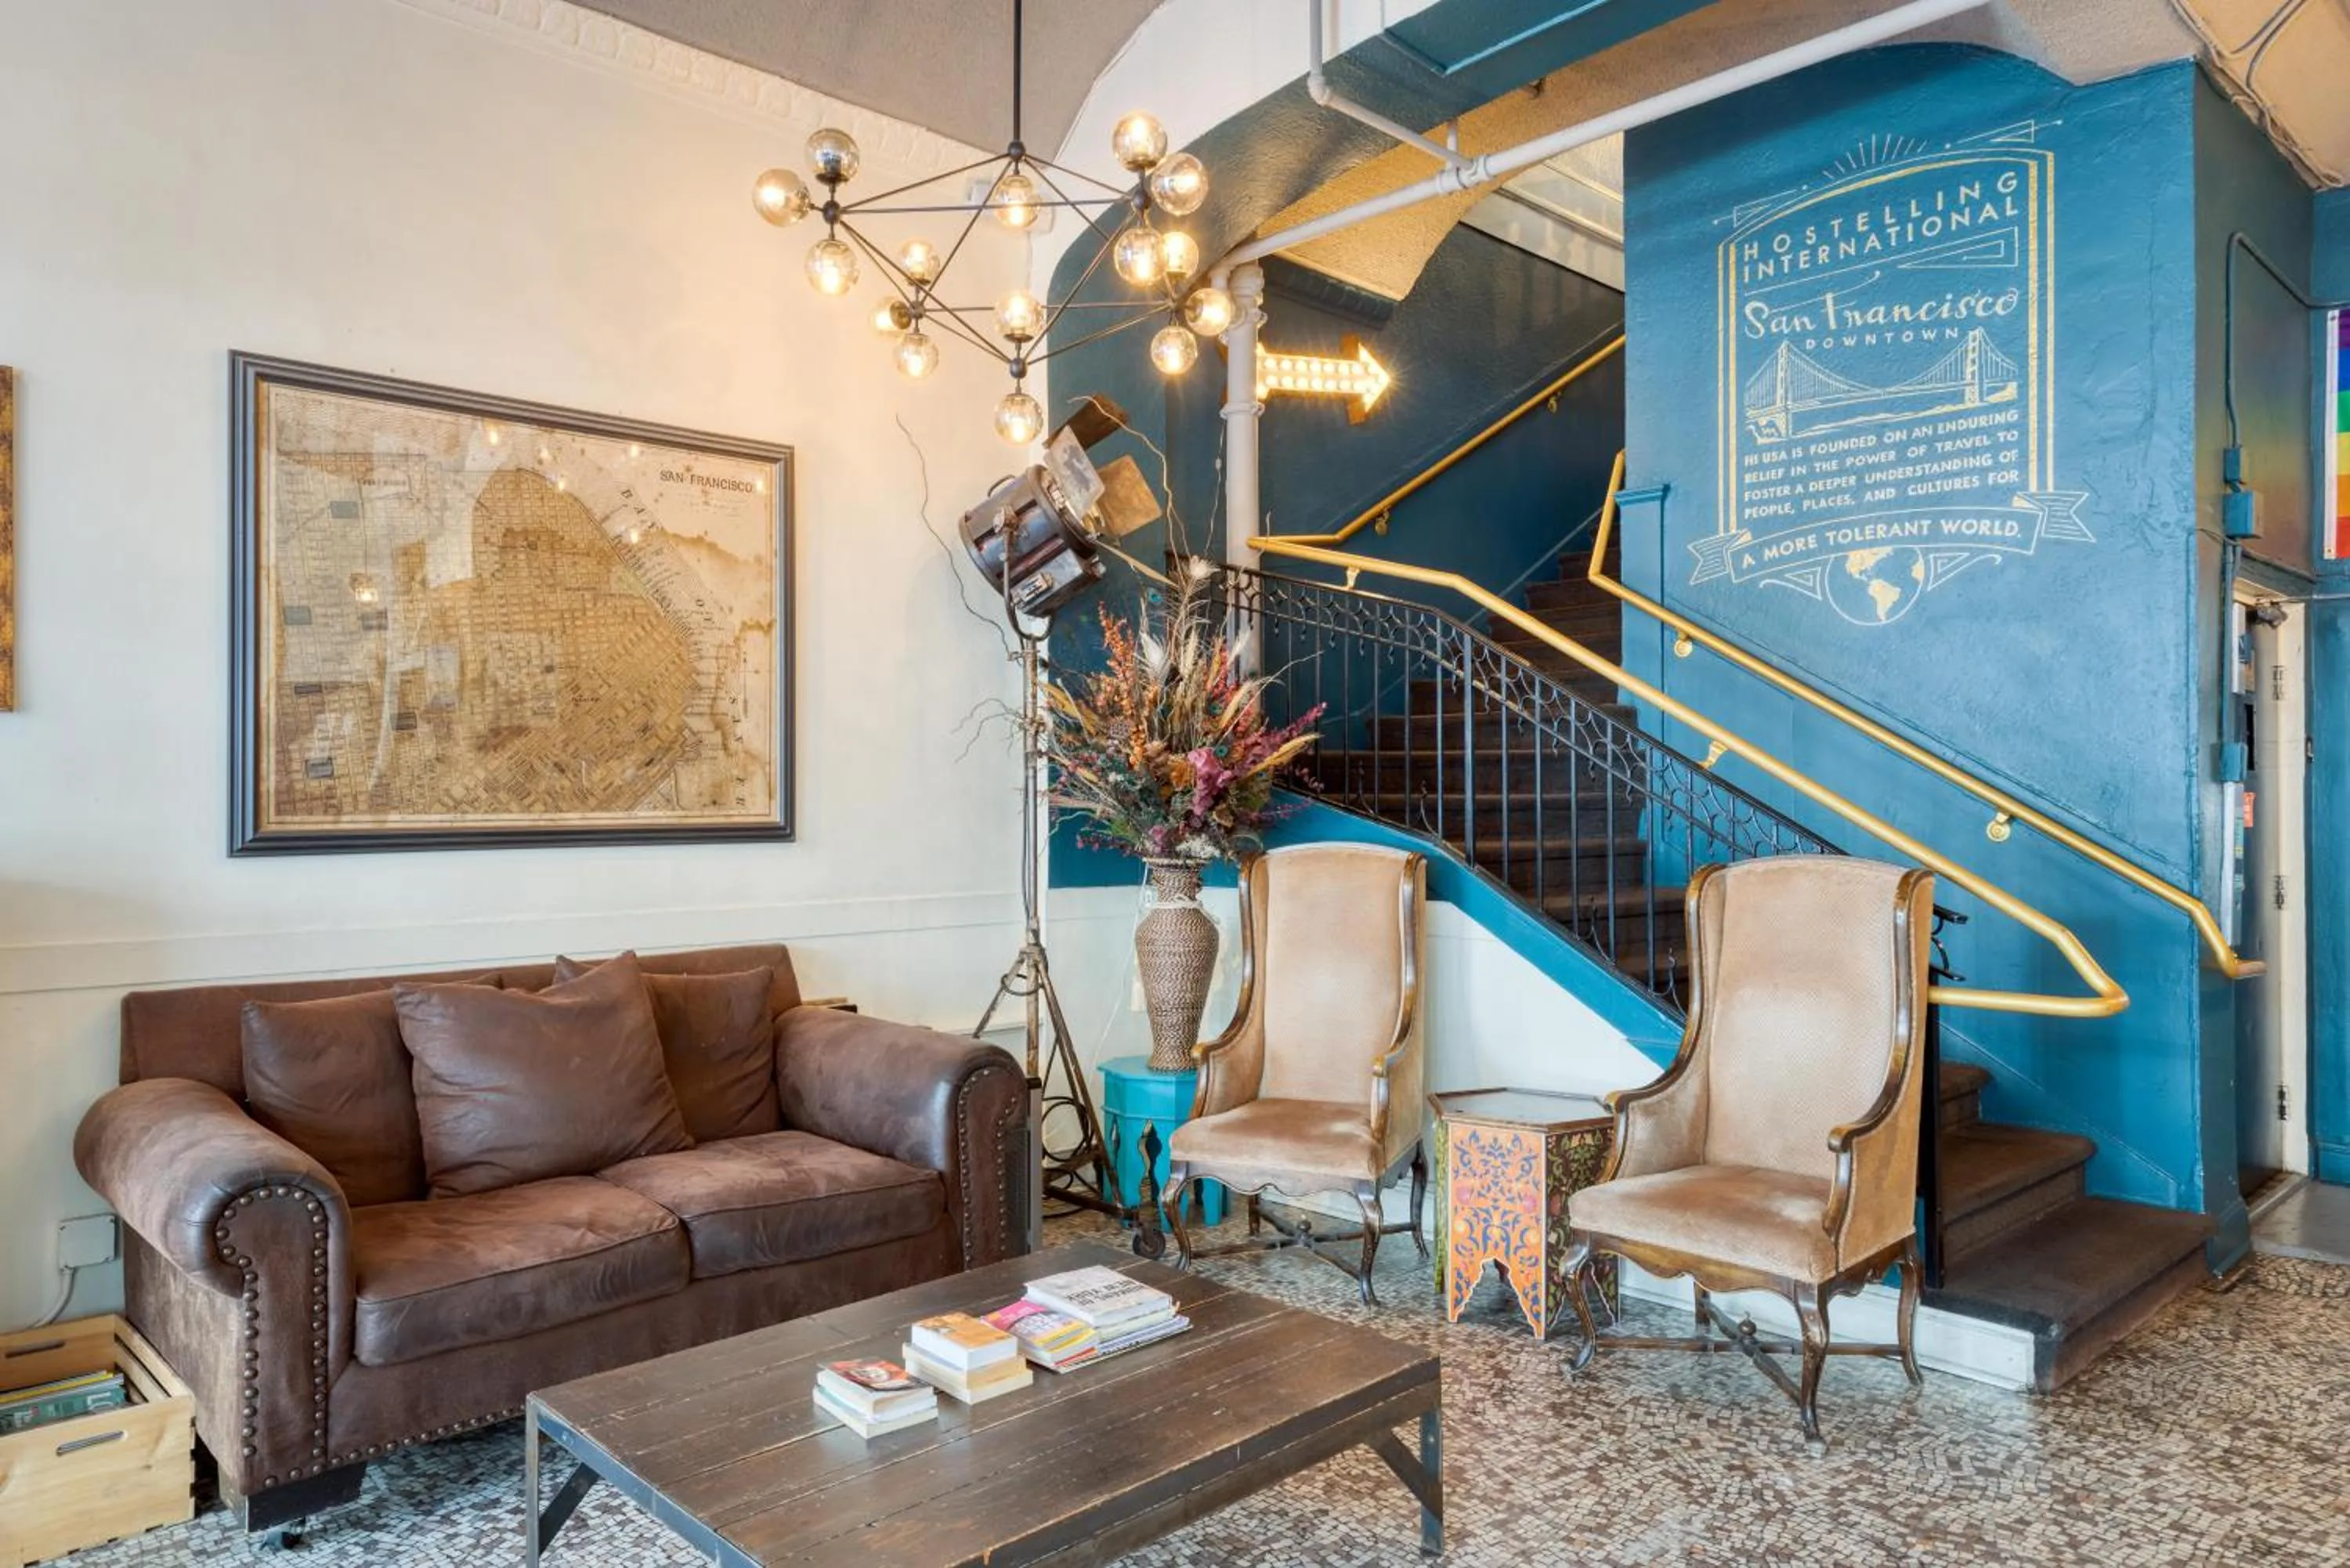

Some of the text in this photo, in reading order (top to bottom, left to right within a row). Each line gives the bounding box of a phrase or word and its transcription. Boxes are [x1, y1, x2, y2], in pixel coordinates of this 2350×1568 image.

[1744, 171, 2018, 261] HOSTELLING
[1744, 196, 2019, 284] INTERNATIONAL
[1744, 280, 2019, 338] San Francisco
[1806, 327, 1960, 351] DOWNTOWN
[1744, 410, 2019, 467] HI USA IS FOUNDED ON AN ENDURING
[1744, 430, 2019, 483] BELIEF IN THE POWER OF TRAVEL TO
[660, 470, 753, 493] SAN FRANCISCO
[1744, 449, 2019, 502] FOSTER A DEEPER UNDERSTANDING OF
[1744, 502, 1795, 520] PEOPLE,
[1863, 487, 1896, 503] AND
[1907, 475, 1980, 497] CULTURES
[1987, 469, 2019, 486] FOR
[1741, 518, 2022, 569] A MORE TOLERANT WORLD.
